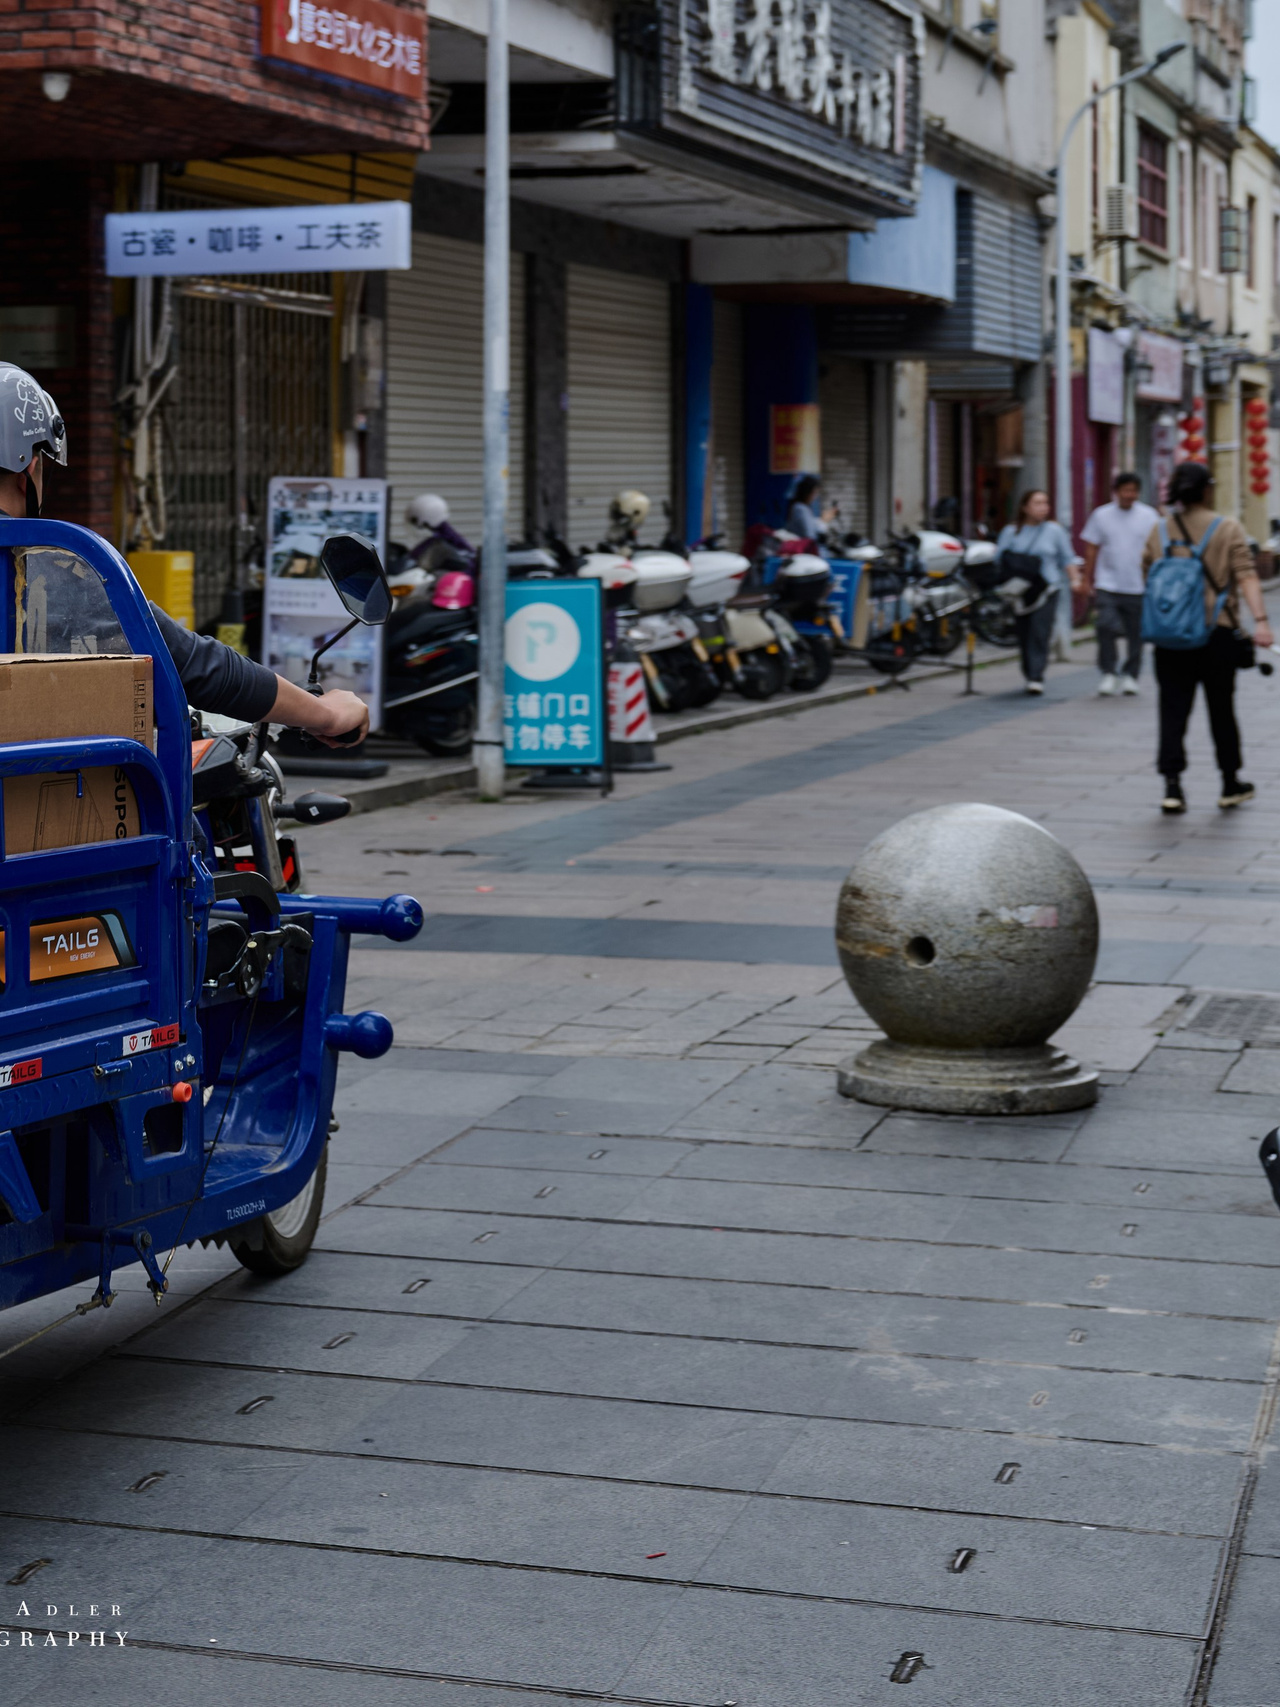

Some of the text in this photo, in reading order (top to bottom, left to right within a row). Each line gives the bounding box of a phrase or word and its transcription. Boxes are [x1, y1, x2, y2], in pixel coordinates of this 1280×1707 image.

[42, 928, 99, 955] TAILG
[69, 951, 96, 962] NEW ENERGY
[141, 1028, 176, 1048] TAILG
[0, 1066, 37, 1084] TAILG
